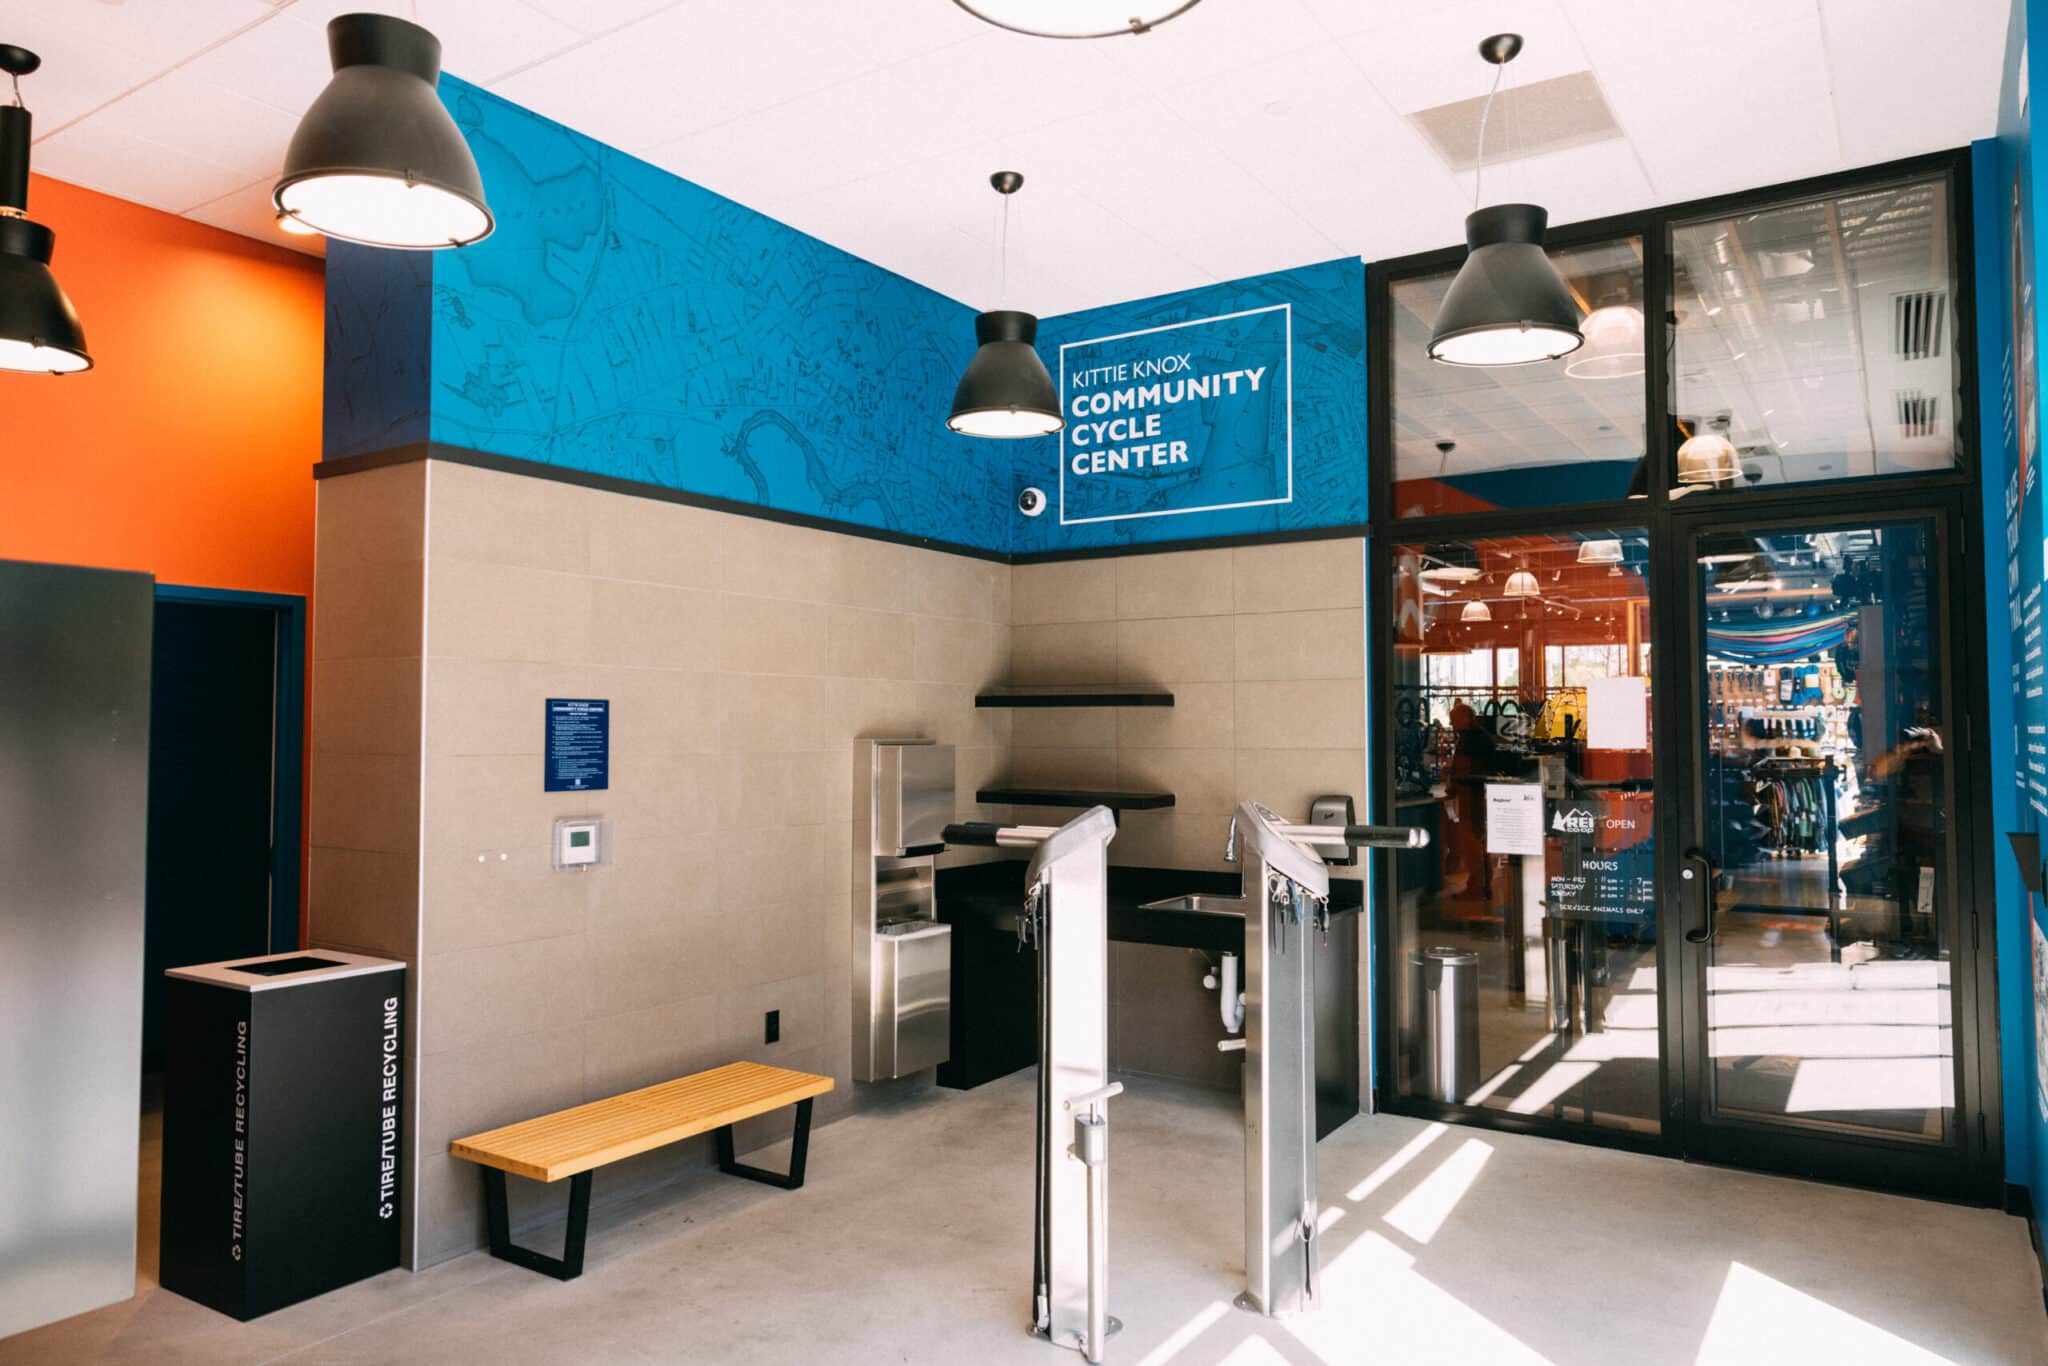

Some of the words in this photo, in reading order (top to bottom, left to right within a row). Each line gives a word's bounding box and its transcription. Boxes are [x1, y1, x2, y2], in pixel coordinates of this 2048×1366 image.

[1072, 364, 1127, 389] KITTIE
[1133, 353, 1192, 378] KNOX
[1071, 366, 1267, 417] COMMUNITY
[1071, 414, 1161, 446] CYCLE
[1071, 440, 1189, 475] CENTER
[1567, 816, 1594, 828] REI
[1606, 819, 1635, 829] OPEN
[1582, 860, 1618, 871] HOURS
[1559, 904, 1591, 912] SERVICE
[1592, 905, 1624, 914] ANIMALS
[1626, 907, 1645, 915] ONLY
[383, 996, 399, 1102] RECYCLING
[235, 1021, 248, 1133] RECYCLING
[380, 1104, 396, 1202] TIRE/TUBE
[232, 1139, 245, 1240] TIRE/TUBE
